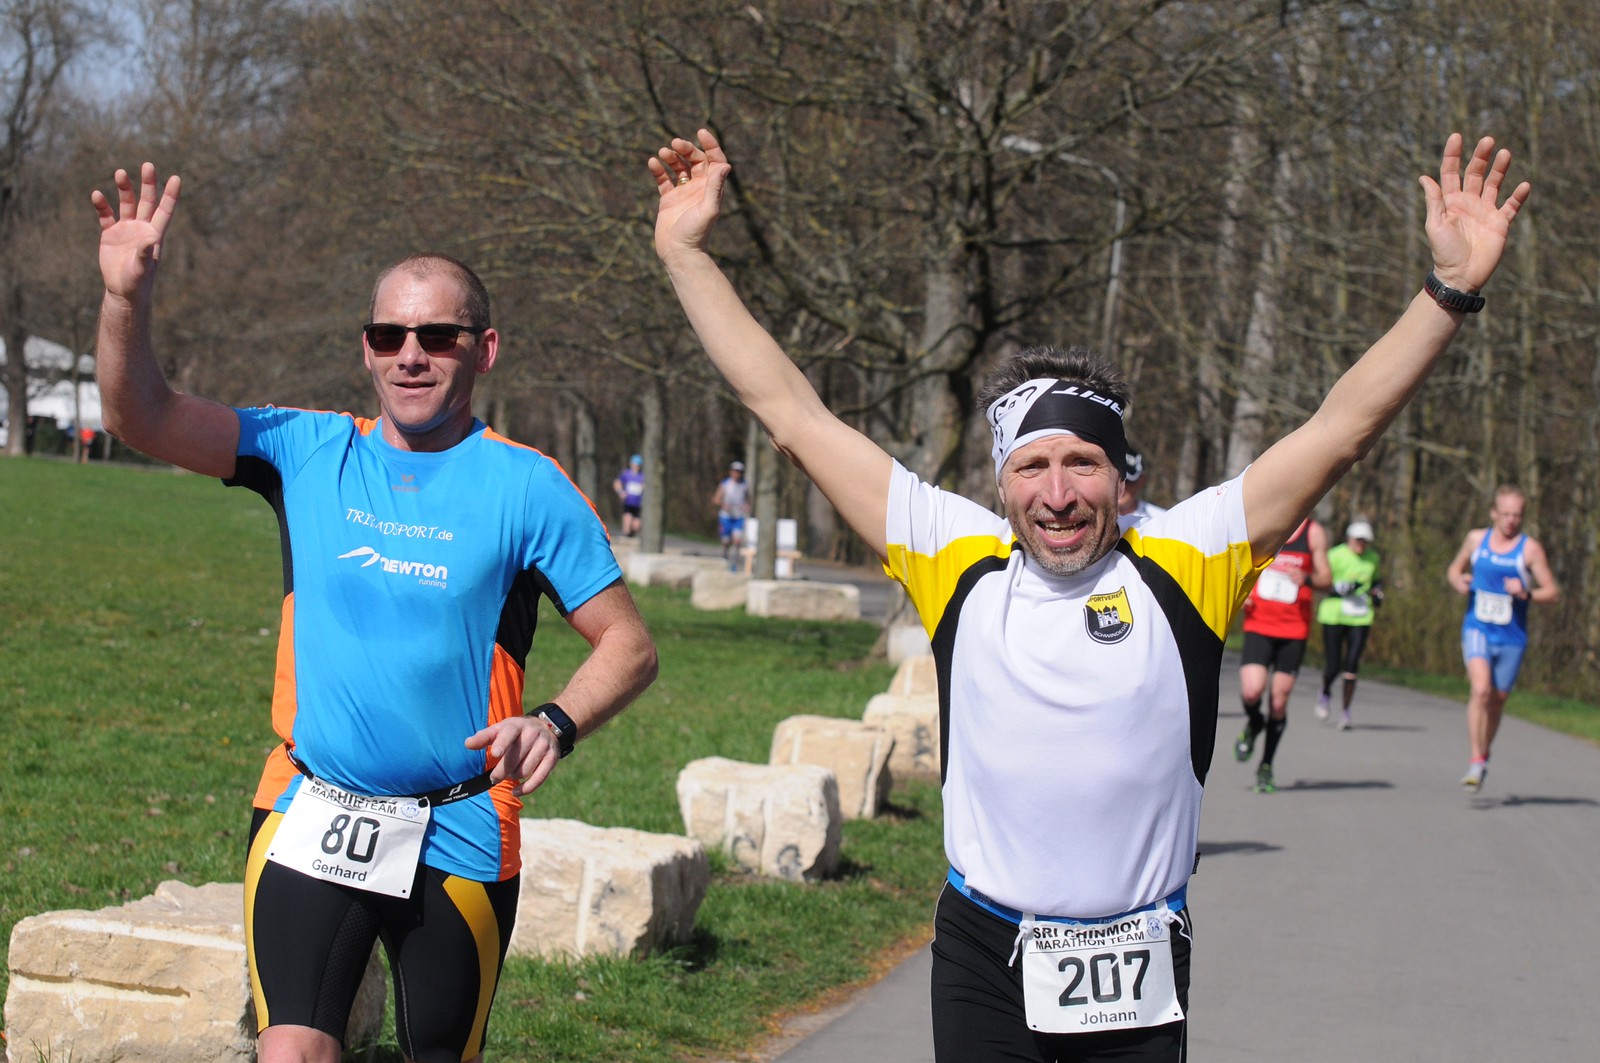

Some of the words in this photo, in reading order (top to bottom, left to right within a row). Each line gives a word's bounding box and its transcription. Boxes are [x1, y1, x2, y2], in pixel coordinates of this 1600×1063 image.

[380, 557, 448, 580] NEWTON
[418, 578, 447, 589] running
[321, 813, 381, 864] 80
[311, 858, 368, 882] Gerhard
[1032, 926, 1058, 939] SRI
[1063, 918, 1142, 940] CHINMOY
[1035, 935, 1106, 950] MARATHON
[1110, 931, 1145, 945] TEAM
[1058, 949, 1151, 1007] 207
[1080, 1010, 1137, 1026] Johann
